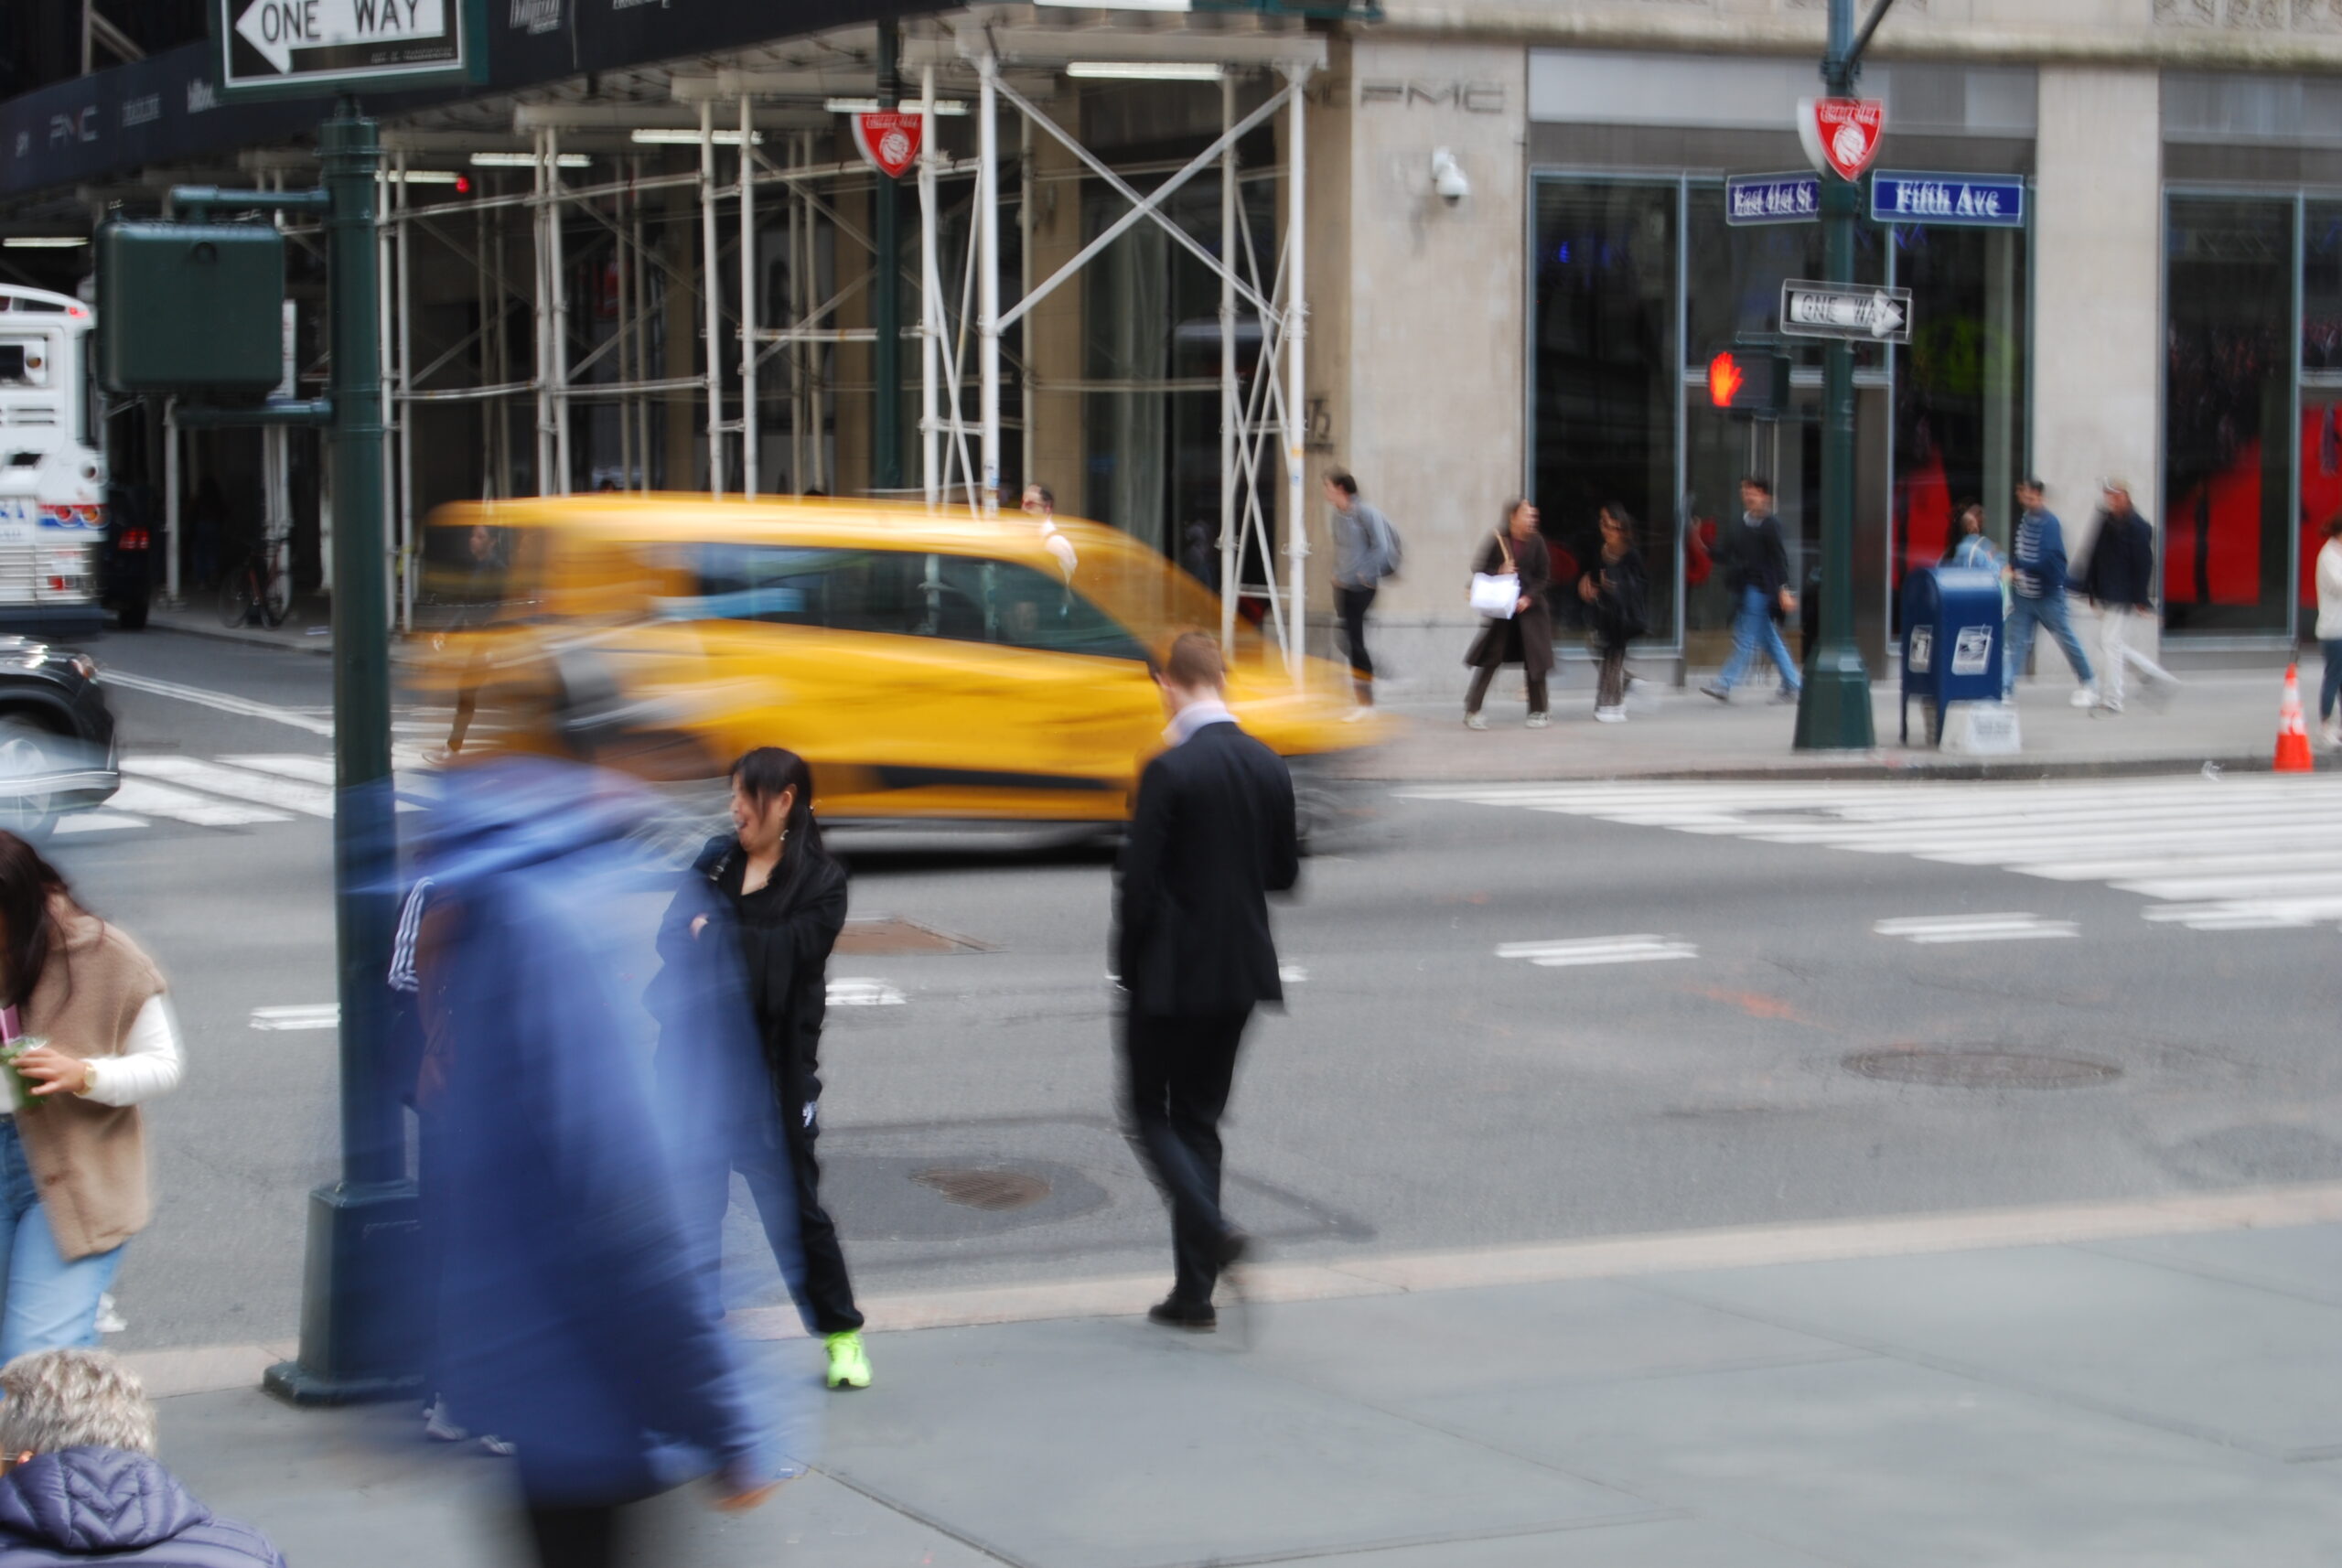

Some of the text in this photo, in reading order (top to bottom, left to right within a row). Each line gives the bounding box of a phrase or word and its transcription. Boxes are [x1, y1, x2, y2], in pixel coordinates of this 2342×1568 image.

[261, 0, 419, 43] ONE WAY
[1796, 180, 1819, 213] St
[1896, 180, 2001, 218] Fifth Ave
[1801, 294, 1838, 322] ONE
